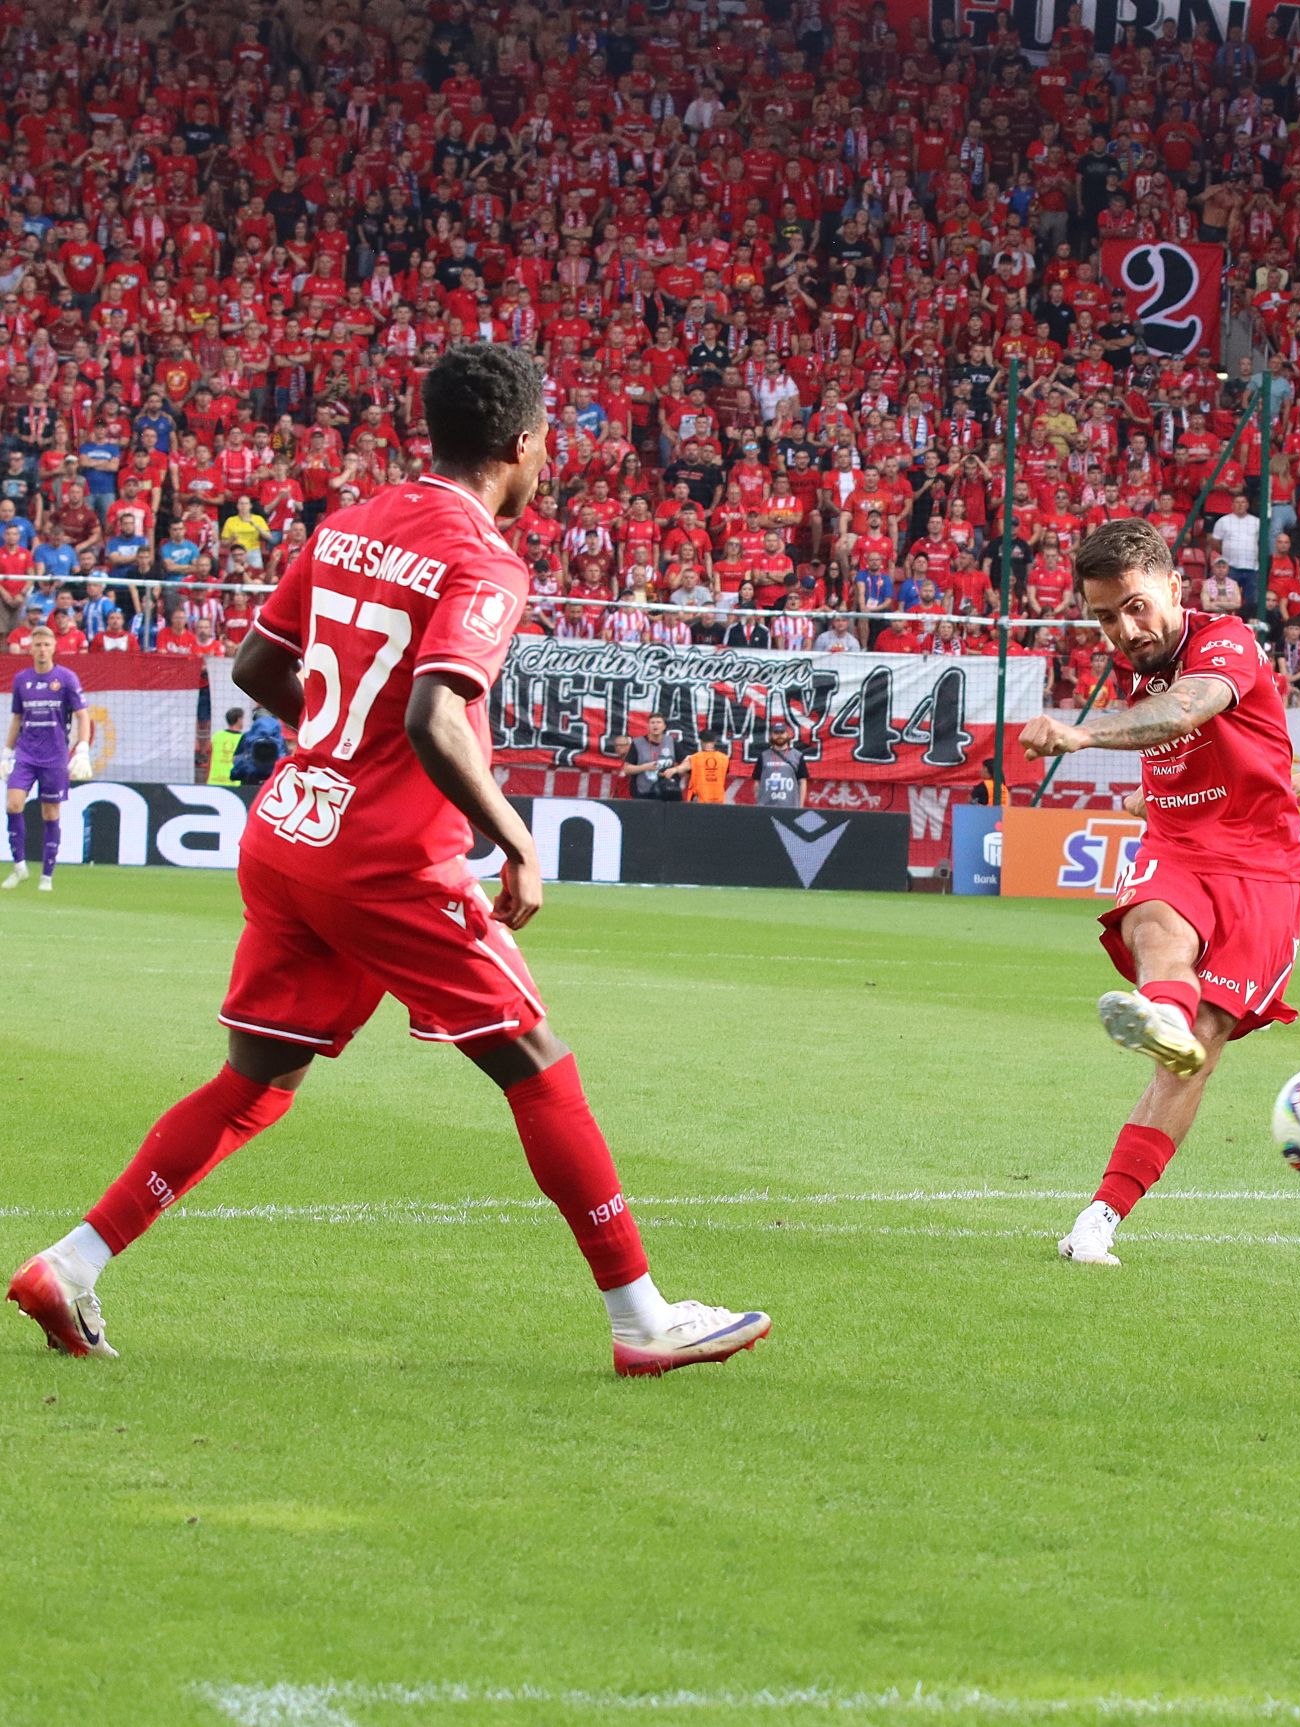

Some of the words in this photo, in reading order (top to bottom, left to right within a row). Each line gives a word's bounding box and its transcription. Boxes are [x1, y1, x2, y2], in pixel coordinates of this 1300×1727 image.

[1121, 242, 1203, 359] 2
[298, 586, 413, 761] 57
[831, 664, 972, 768] 44
[973, 873, 998, 884] Bank
[588, 1192, 625, 1226] 1910
